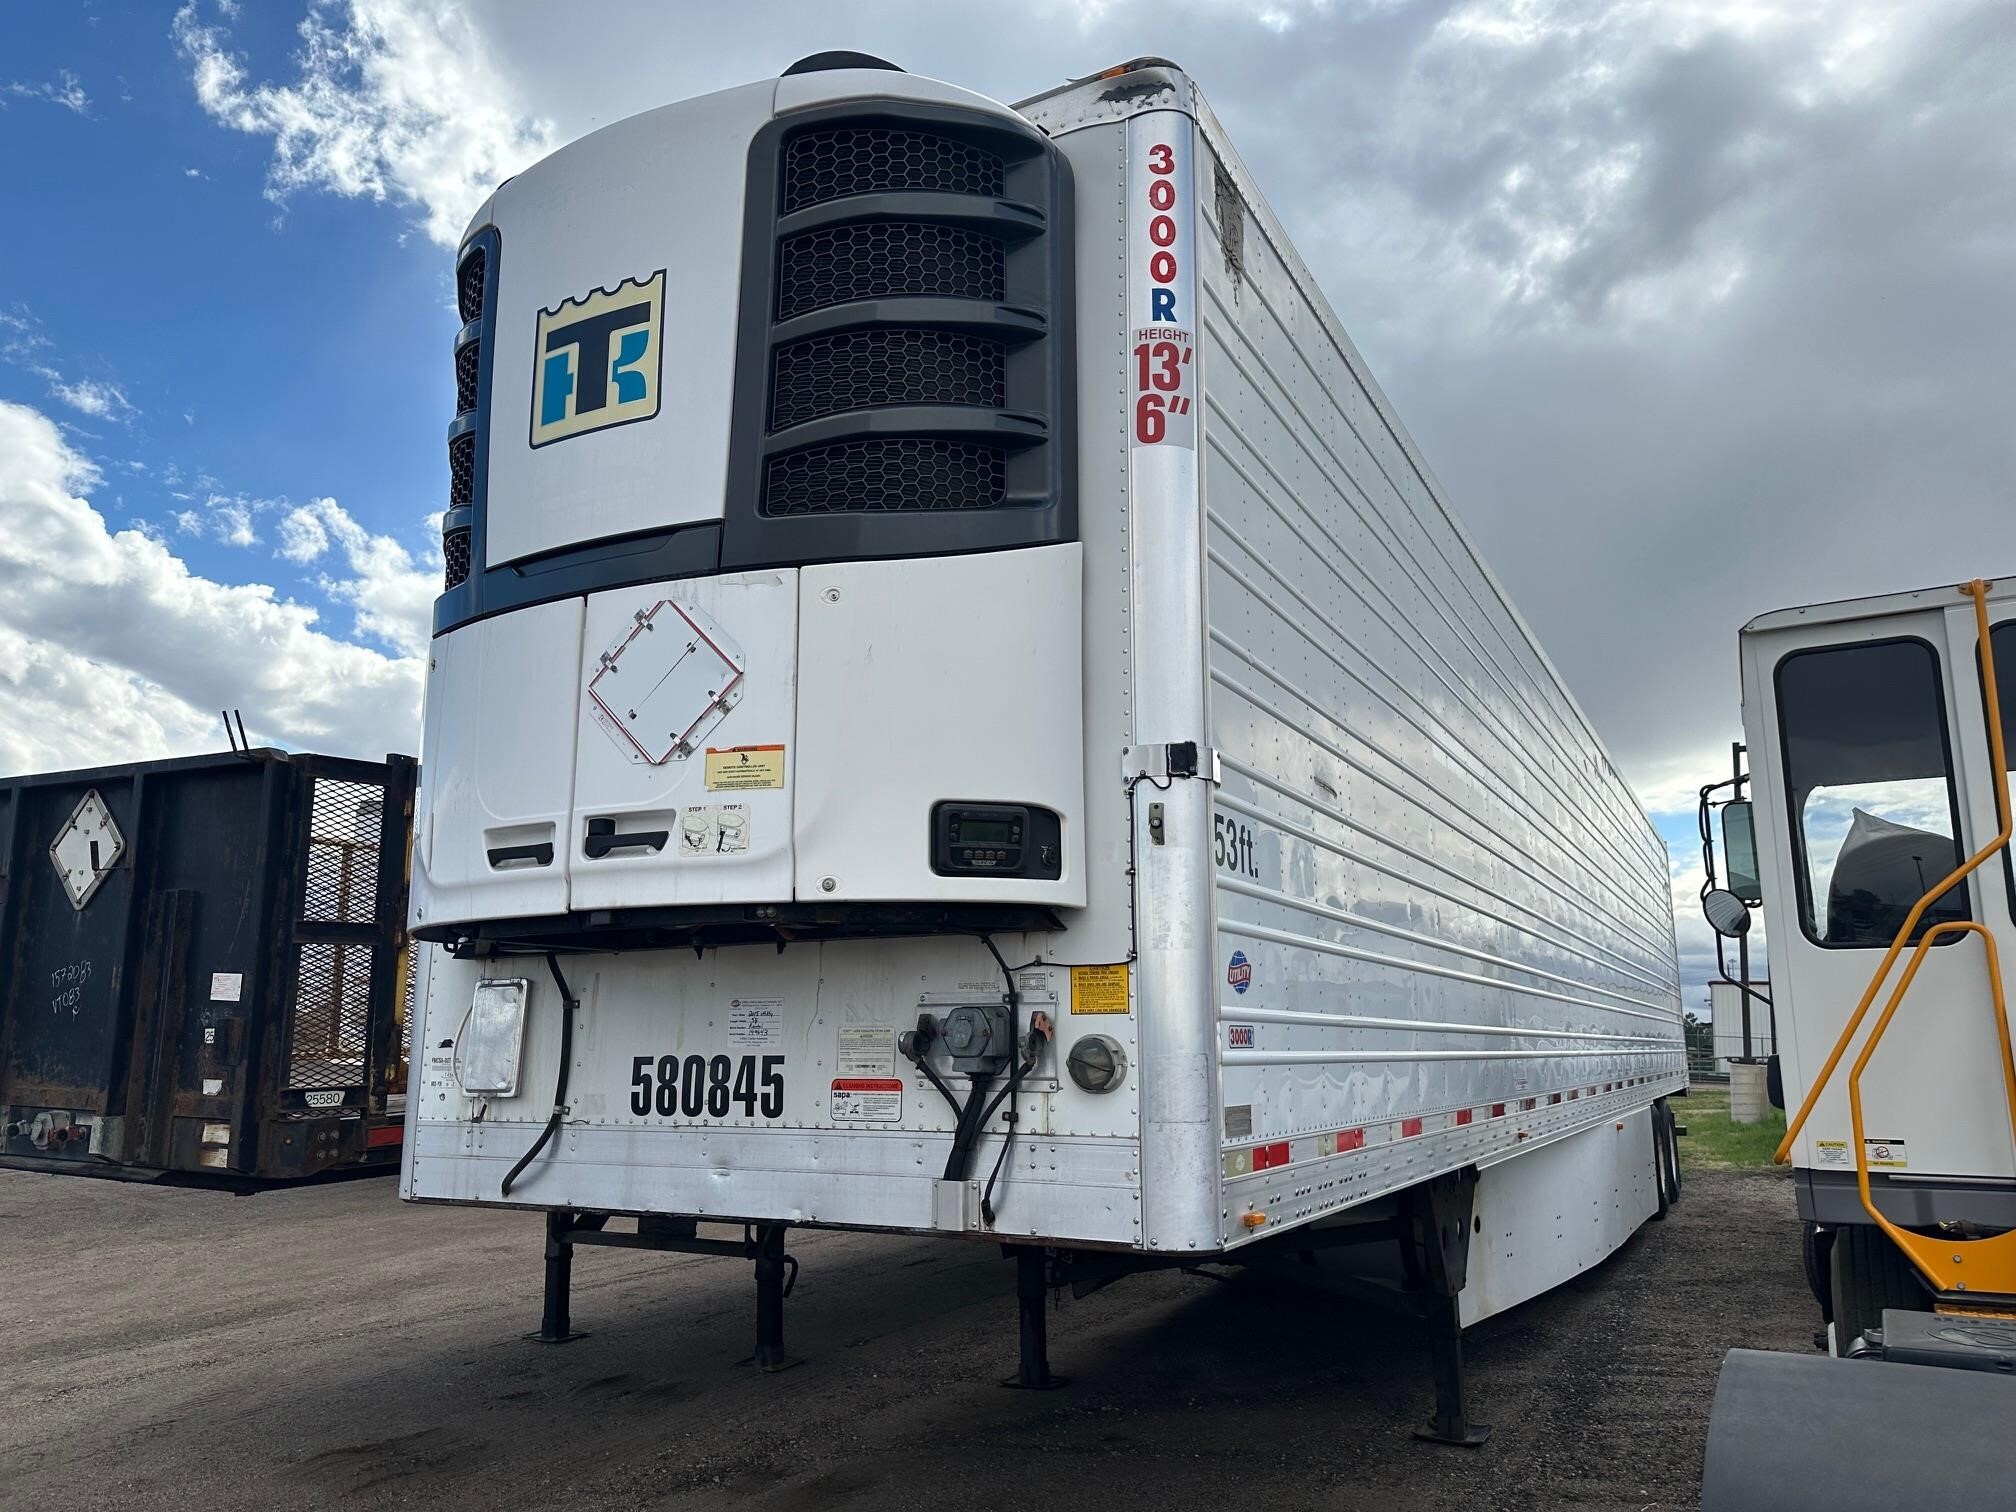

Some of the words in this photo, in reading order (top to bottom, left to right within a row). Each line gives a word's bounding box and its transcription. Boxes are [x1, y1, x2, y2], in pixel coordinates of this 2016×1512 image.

[1139, 328, 1189, 343] HEIGHT
[1133, 341, 1192, 392] 13'
[1214, 812, 1259, 879] 53ft.
[1229, 964, 1251, 983] UTILITY
[1230, 1028, 1253, 1046] 3000R
[631, 1054, 785, 1118] 580845
[833, 1091, 850, 1099] sapa
[306, 1093, 341, 1105] 25580
